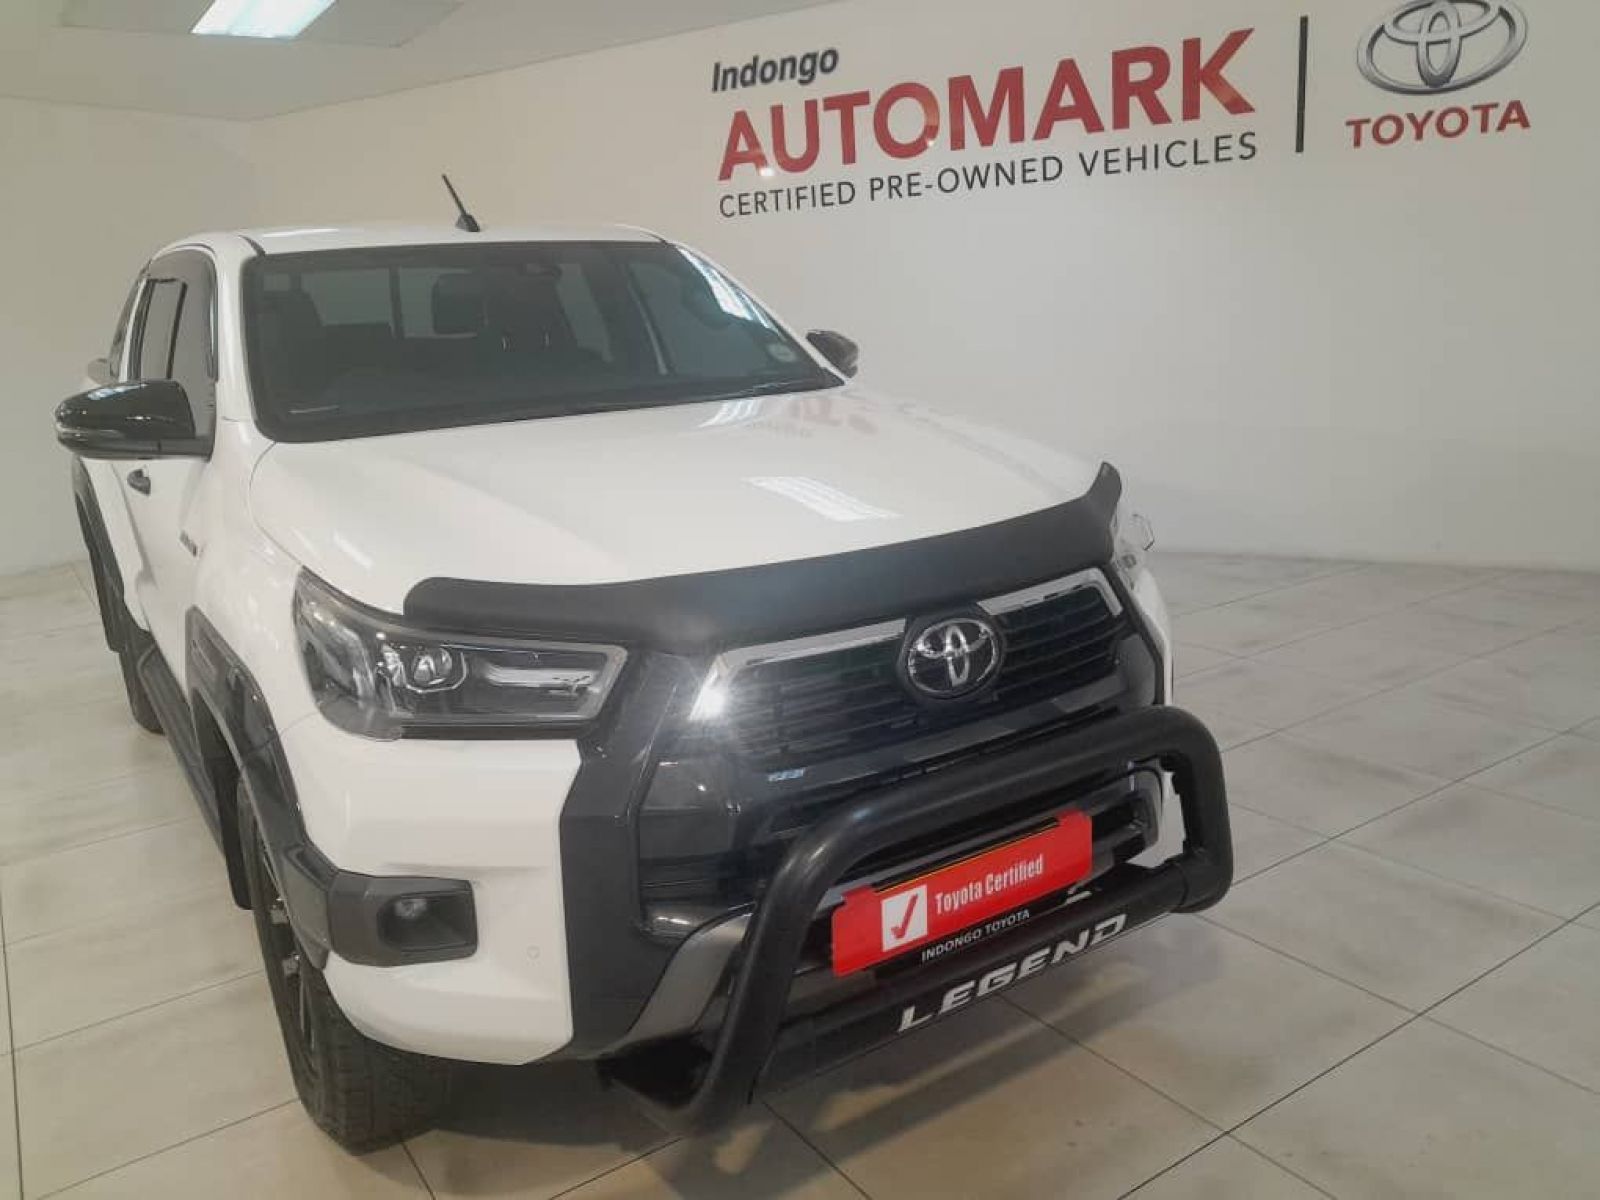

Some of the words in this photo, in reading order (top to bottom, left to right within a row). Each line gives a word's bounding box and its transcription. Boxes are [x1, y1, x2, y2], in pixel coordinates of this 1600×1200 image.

[711, 46, 839, 92] Indongo
[718, 28, 1256, 181] AUTOMARK
[1346, 100, 1531, 149] TOYOTA
[719, 181, 855, 218] CERTIFIED
[870, 155, 1063, 201] PRE-OWNED
[1079, 131, 1257, 177] VEHICLES
[935, 878, 982, 916] Toyota
[985, 853, 1044, 895] Certified
[921, 928, 982, 962] INDONGO
[986, 909, 1031, 935] TOYOTA
[897, 913, 1127, 1033] LEGEND
